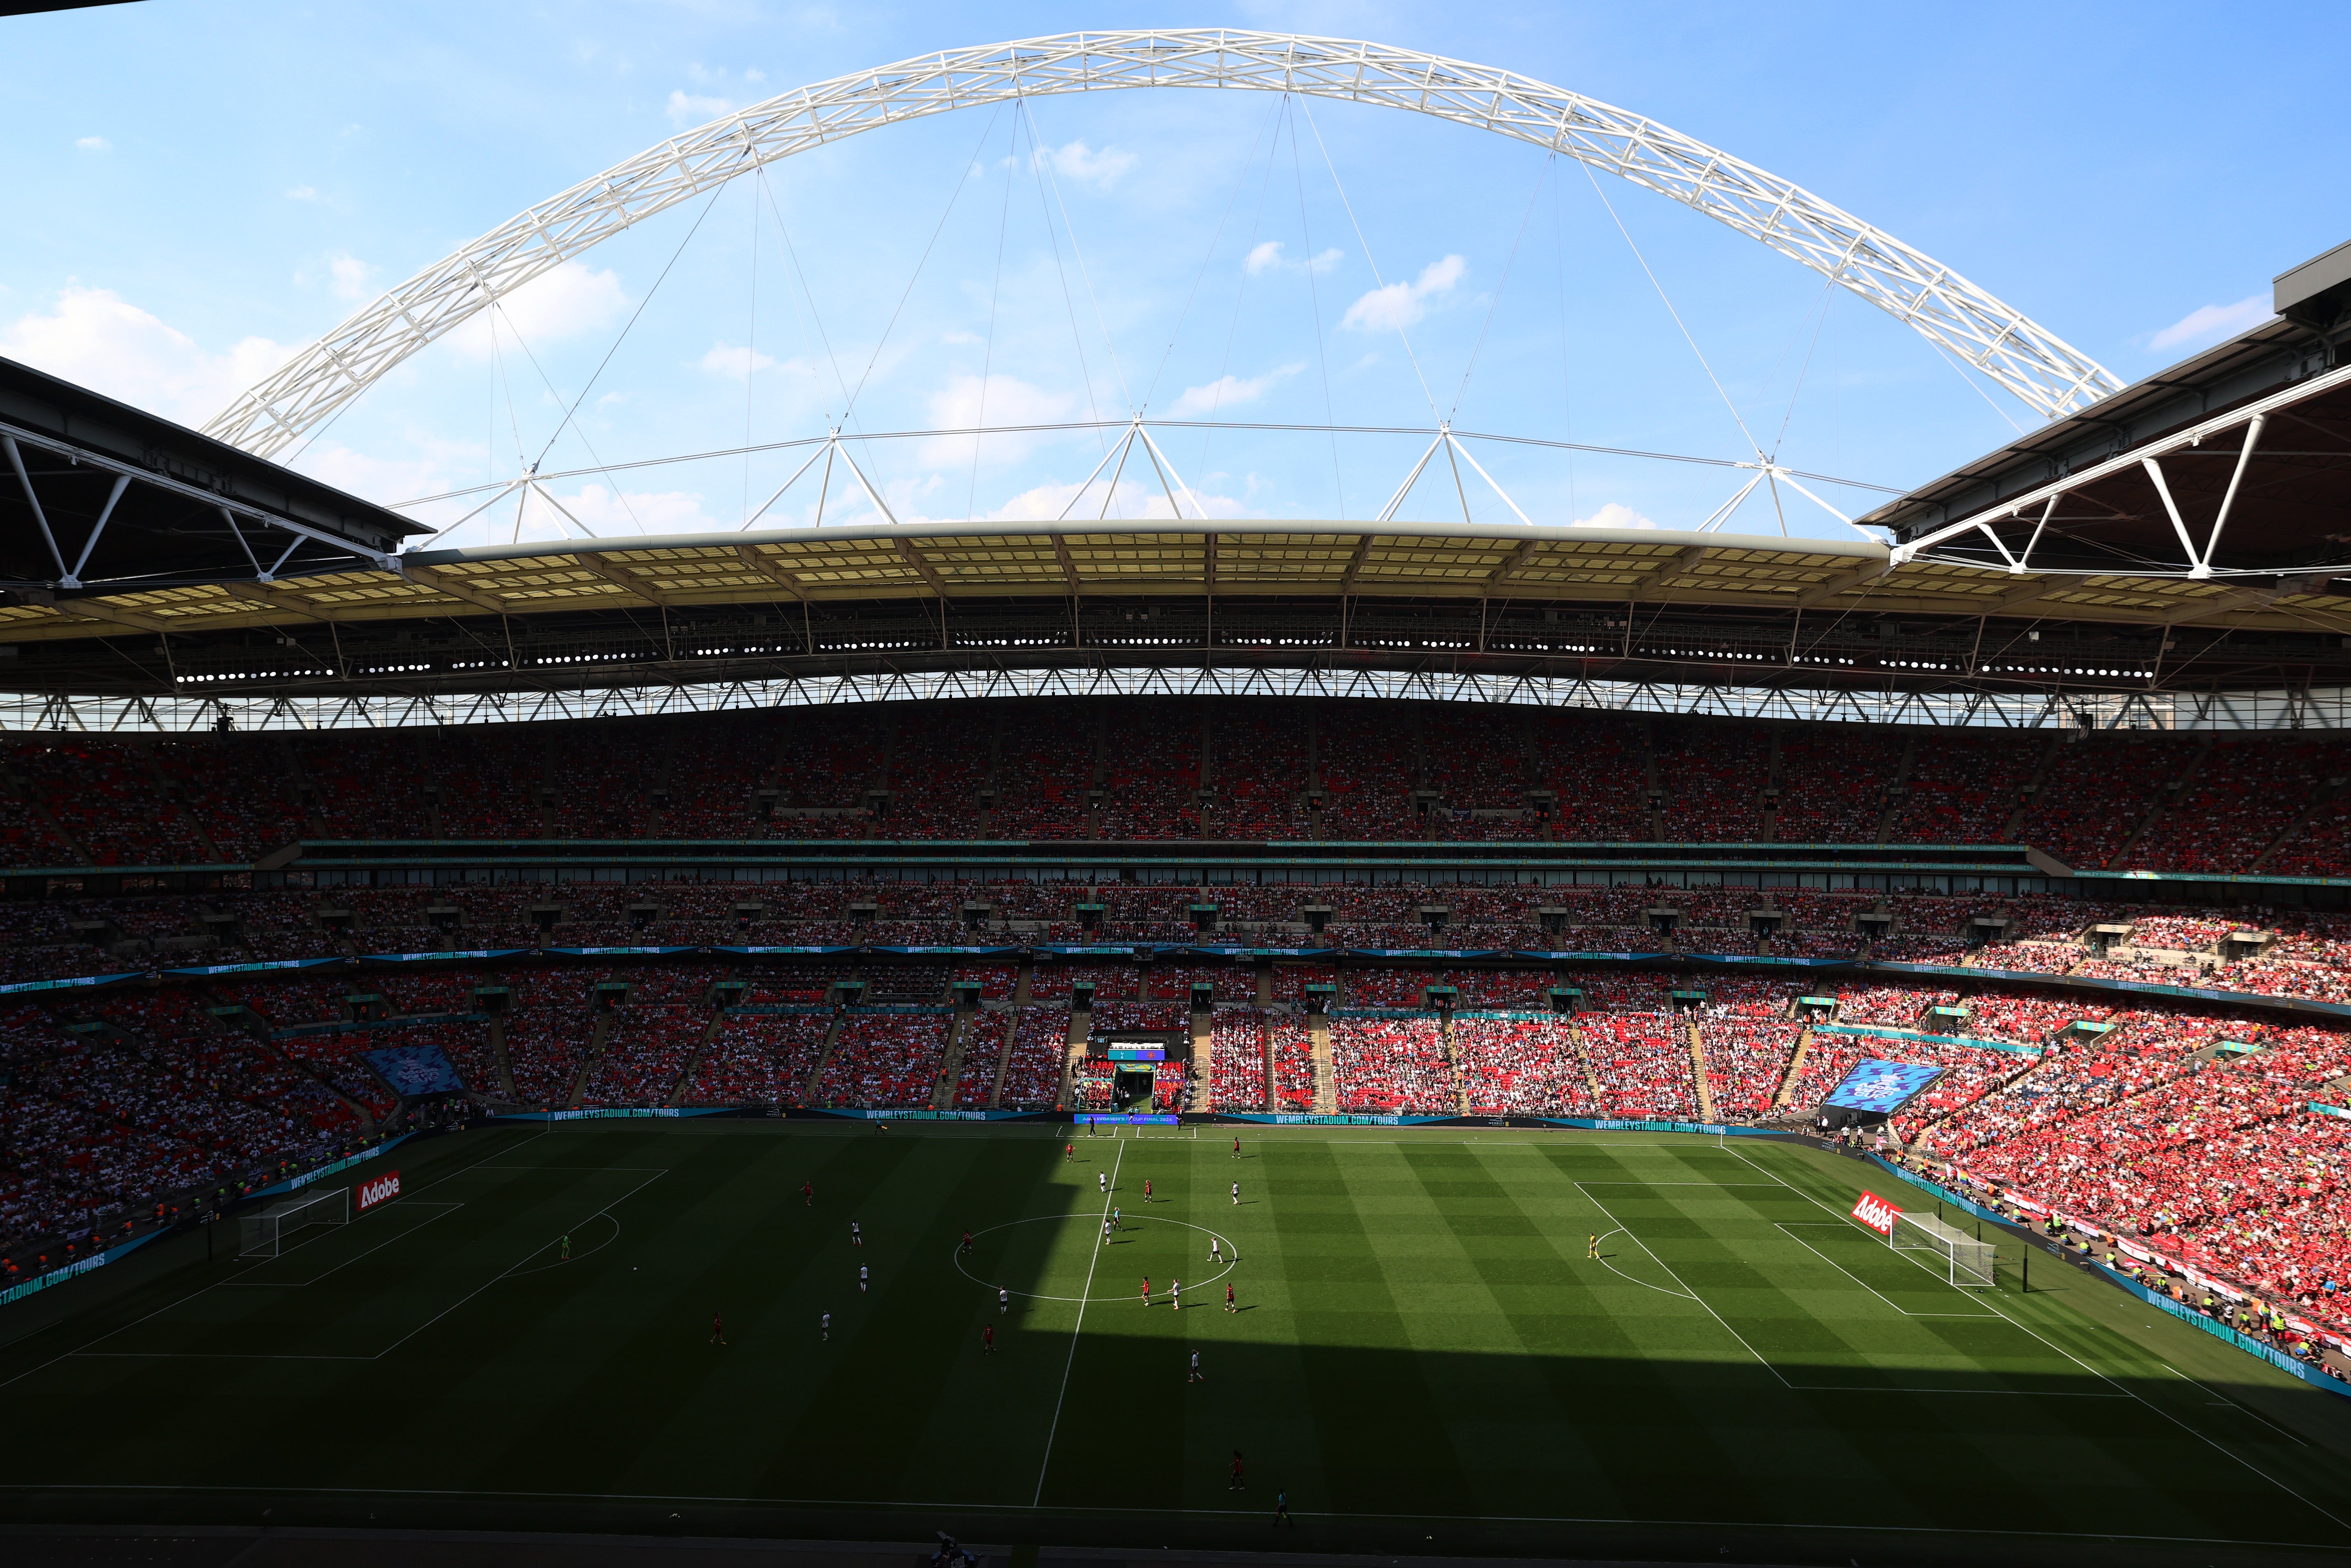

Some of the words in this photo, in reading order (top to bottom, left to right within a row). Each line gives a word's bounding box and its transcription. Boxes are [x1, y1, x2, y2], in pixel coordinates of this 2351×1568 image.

[403, 950, 487, 961] WEMBLEYSTADIUM.COM/TOURS
[1725, 955, 1810, 966] WEMBLEYSTADIUM.COM/TOURS
[209, 960, 299, 974] WEMBLEYSTADIUM.COM/TOURS
[1914, 965, 2006, 978] WEMBLEYSTADIUM.COM/TOURS
[0, 977, 95, 994] MBLEYSTADIUM.COM/TOURS
[1855, 1087, 1894, 1096] WFA
[1856, 1083, 1901, 1092] Adobe
[554, 1108, 679, 1121] WEMBLEYSTADIUM.COM/TOURS
[867, 1110, 986, 1121] WEMBLEYSTADIUM.COM/TOURS
[1276, 1115, 1399, 1125] WEMBLEYSTADIUM.COM/TOURS
[1595, 1120, 1726, 1135] WEMBLEYSTADIUM.COM/TOURS
[291, 1146, 379, 1190] WEMBLEYSTADIUM.COM/TOURS
[361, 1177, 399, 1209] Adobe
[1897, 1167, 1977, 1216] WEMBLEYSTADIUM.COM/TOURS
[1852, 1195, 1890, 1231] Adobe
[2147, 1289, 2305, 1379] WEMBLEYSTADIUM.COM/TOURS
